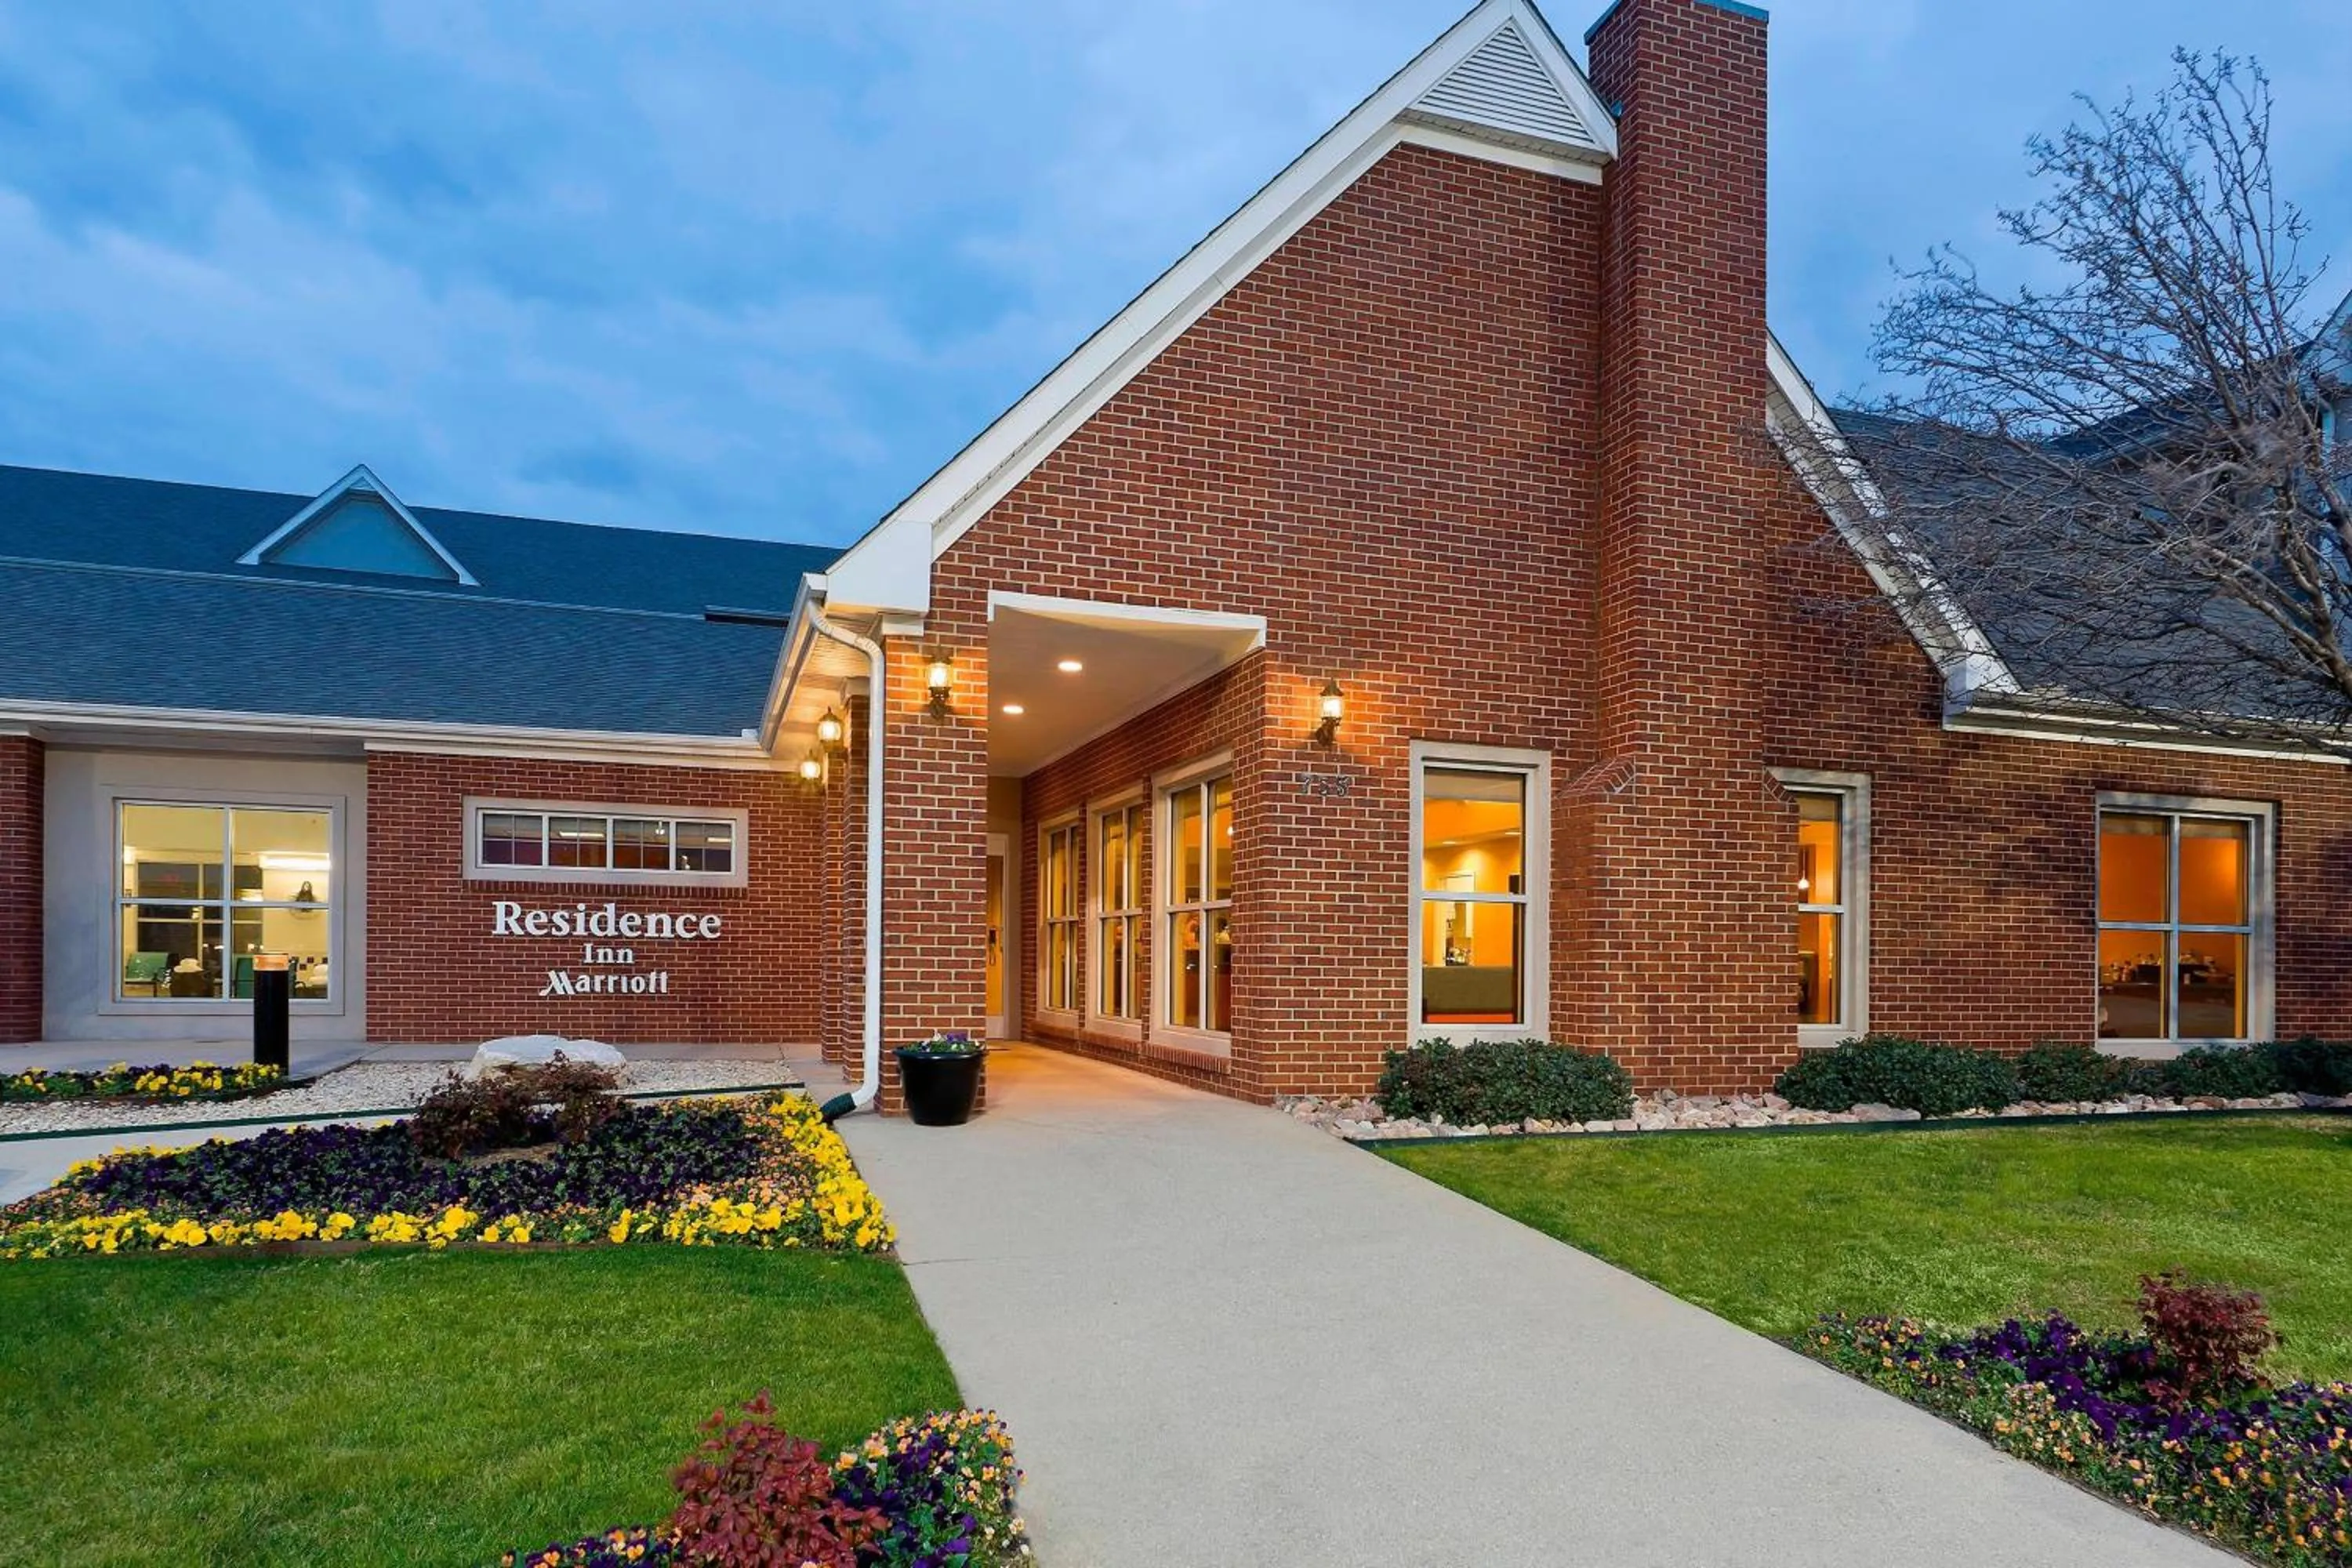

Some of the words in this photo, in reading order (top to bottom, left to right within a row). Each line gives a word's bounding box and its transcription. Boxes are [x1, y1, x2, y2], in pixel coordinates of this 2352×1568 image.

[492, 901, 722, 939] Residence
[582, 942, 636, 965] Inn
[539, 969, 670, 996] Marriott
